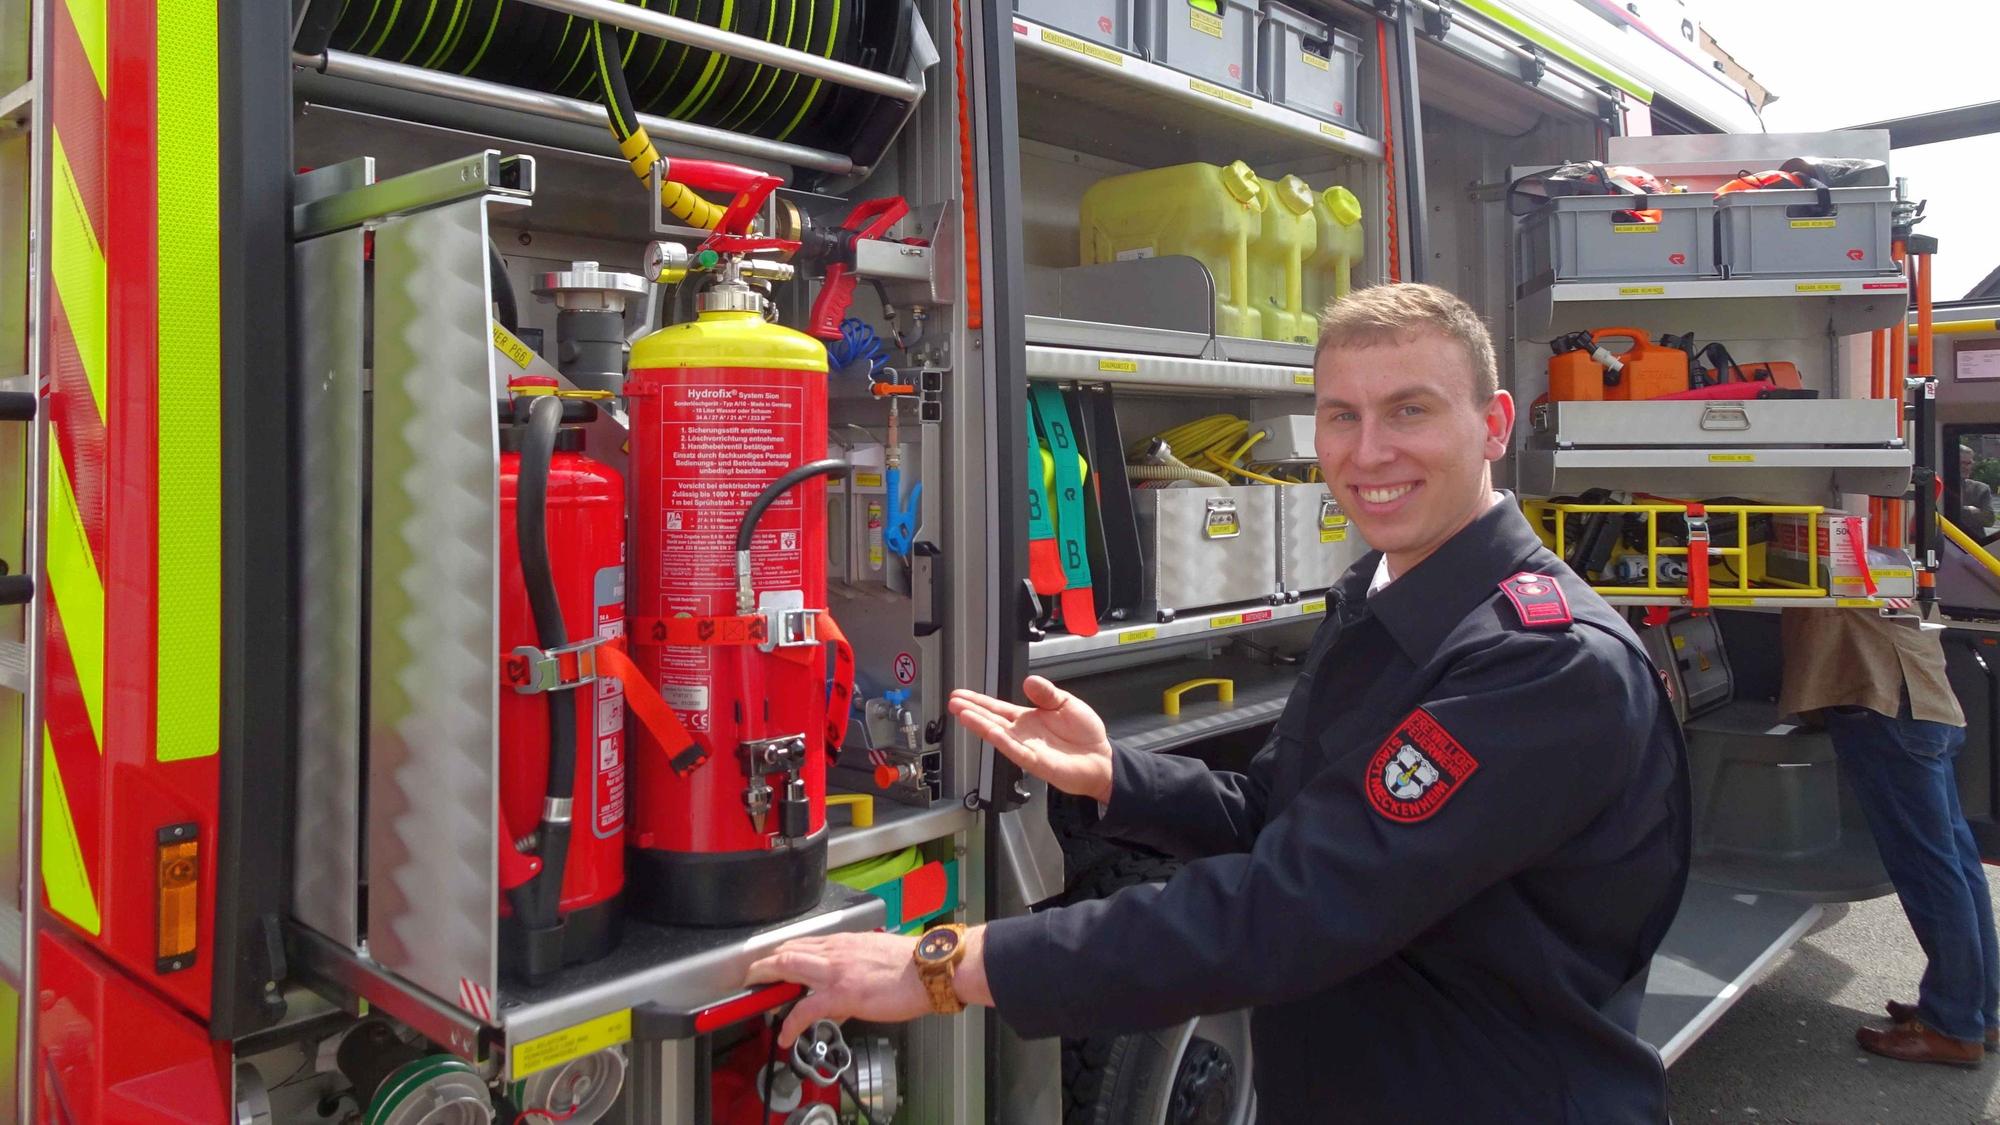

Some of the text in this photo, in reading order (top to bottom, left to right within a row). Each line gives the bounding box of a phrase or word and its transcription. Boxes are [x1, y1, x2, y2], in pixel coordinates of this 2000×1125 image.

[509, 344, 527, 362] PG6
[739, 391, 763, 399] System
[1051, 421, 1069, 449] B
[718, 452, 764, 460] fachkundiges
[733, 460, 789, 468] Betriebsanleitung
[694, 499, 735, 507] Sprühstrahl
[1066, 539, 1081, 569] B
[1404, 721, 1465, 781] FEUERWEHR
[1413, 714, 1473, 772] FREIWILLIGE
[1371, 778, 1450, 816] MECKENHEIM
